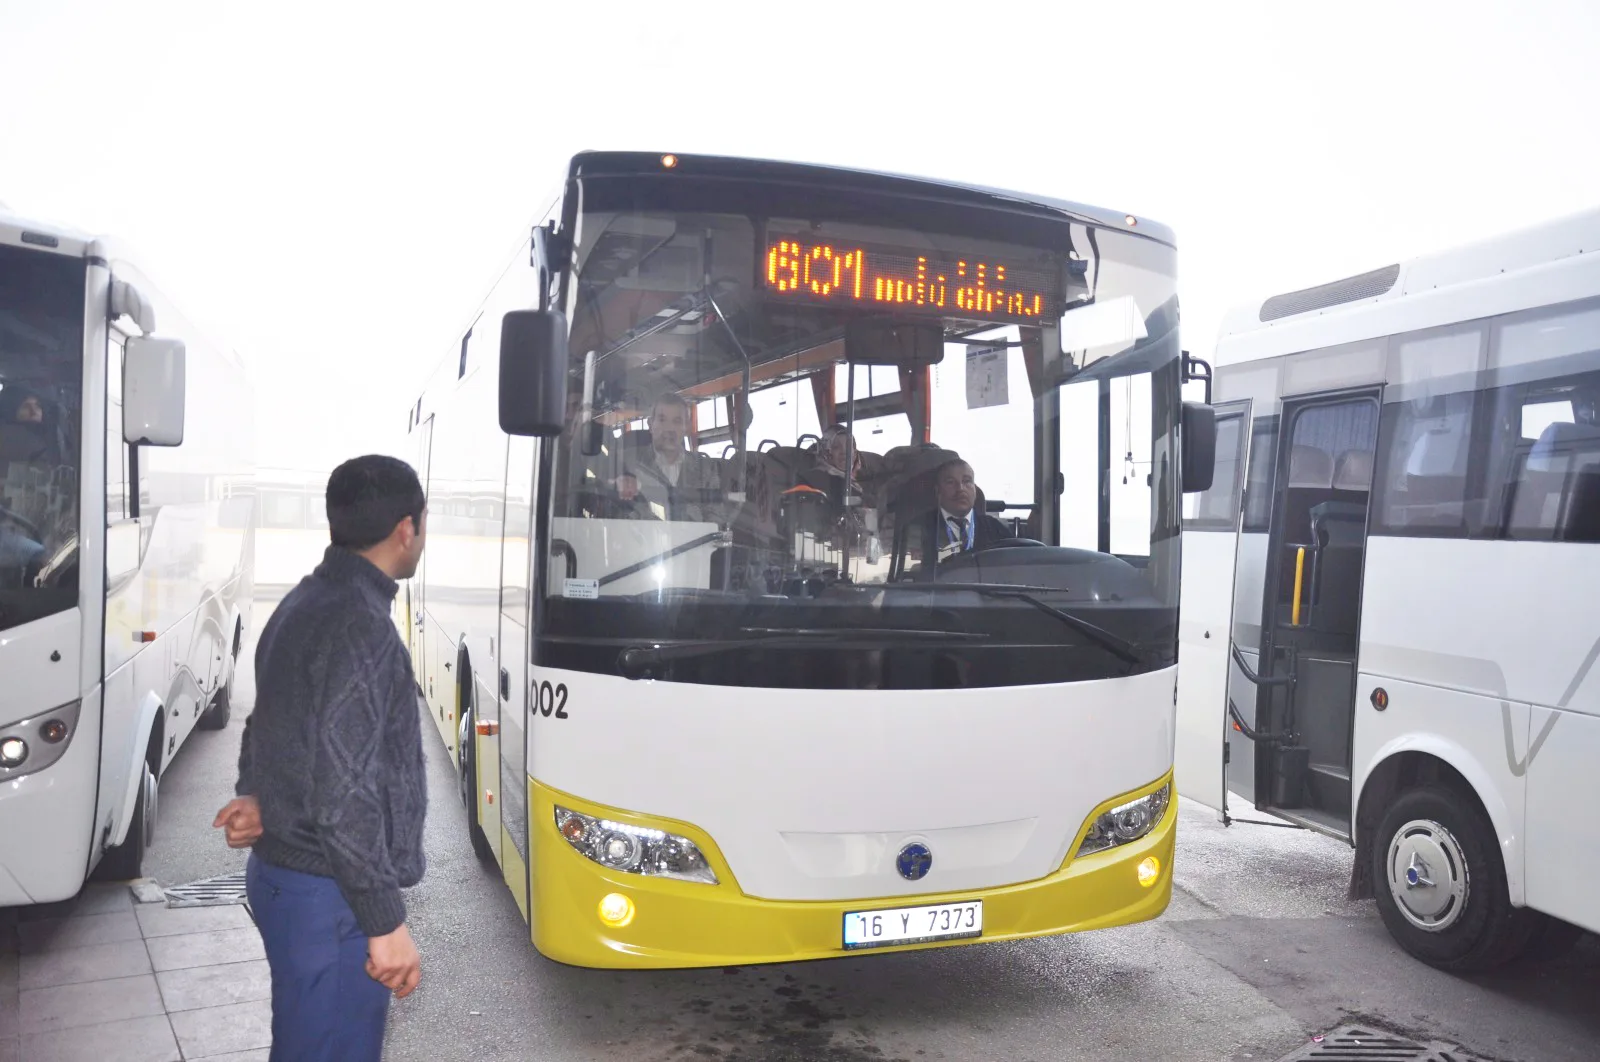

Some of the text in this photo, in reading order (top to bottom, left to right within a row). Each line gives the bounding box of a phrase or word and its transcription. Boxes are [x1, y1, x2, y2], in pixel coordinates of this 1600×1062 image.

[768, 240, 863, 299] 601
[859, 907, 976, 938] 16 Y 7373
